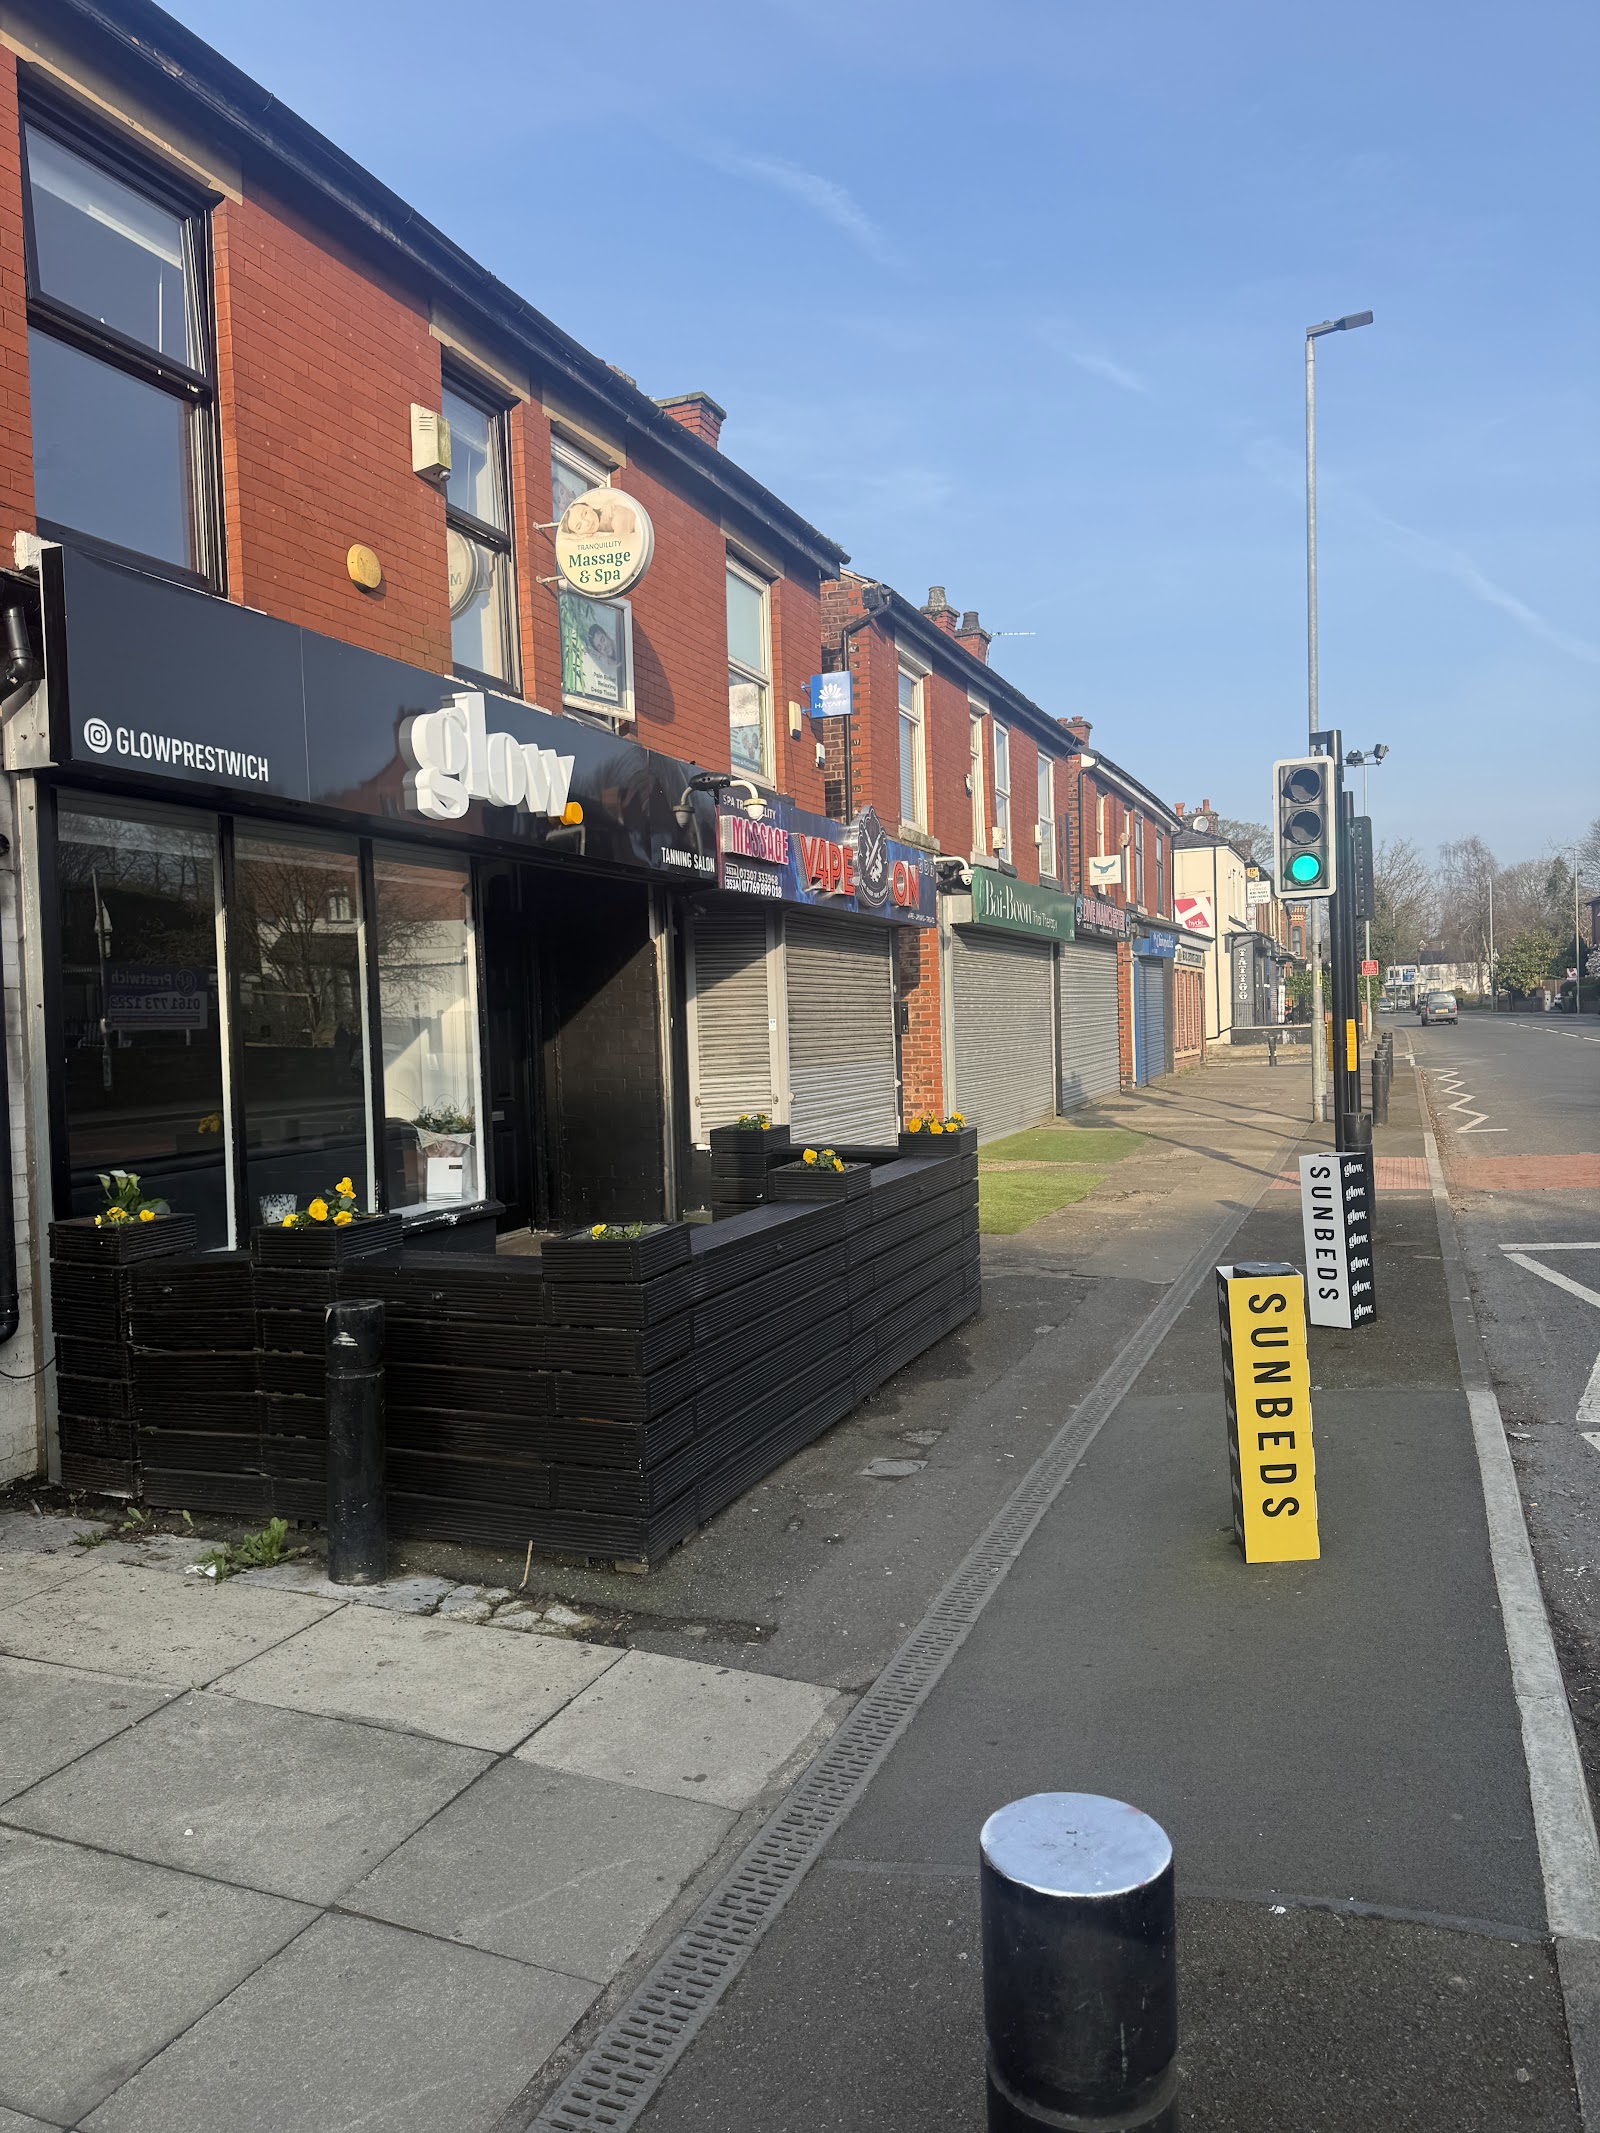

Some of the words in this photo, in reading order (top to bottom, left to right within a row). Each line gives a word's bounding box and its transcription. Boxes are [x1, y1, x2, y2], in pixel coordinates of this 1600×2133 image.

[577, 540, 622, 551] TRANQUILLITY
[568, 551, 631, 568] Massage
[579, 569, 591, 583] &
[594, 568, 621, 585] Spa
[116, 726, 269, 782] GLOWPRESTWICH
[722, 794, 735, 808] SPA
[731, 815, 789, 865] MASSAGE
[660, 846, 692, 869] TANNING
[693, 854, 716, 873] SALON
[739, 867, 757, 882] 07307
[725, 878, 740, 891] 353A
[741, 879, 760, 895] 07769
[760, 882, 772, 897] 899
[892, 859, 920, 910] ON
[985, 879, 1032, 924] Bai-Boon
[1083, 897, 1096, 924] DIVE
[1095, 902, 1125, 932] MANCHESTER
[1188, 918, 1204, 928] hyde
[1238, 948, 1248, 1000] TATTOO
[1344, 1162, 1364, 1178] glow.
[1345, 1185, 1366, 1201] glow.
[1347, 1208, 1367, 1226] glow.
[1310, 1166, 1339, 1300] SUNBEDS
[1348, 1233, 1369, 1249] glow.
[1350, 1256, 1370, 1273] glow.
[1352, 1279, 1372, 1297] glow.
[1353, 1303, 1374, 1321] glow.
[1248, 1293, 1300, 1518] SUNBEDS
